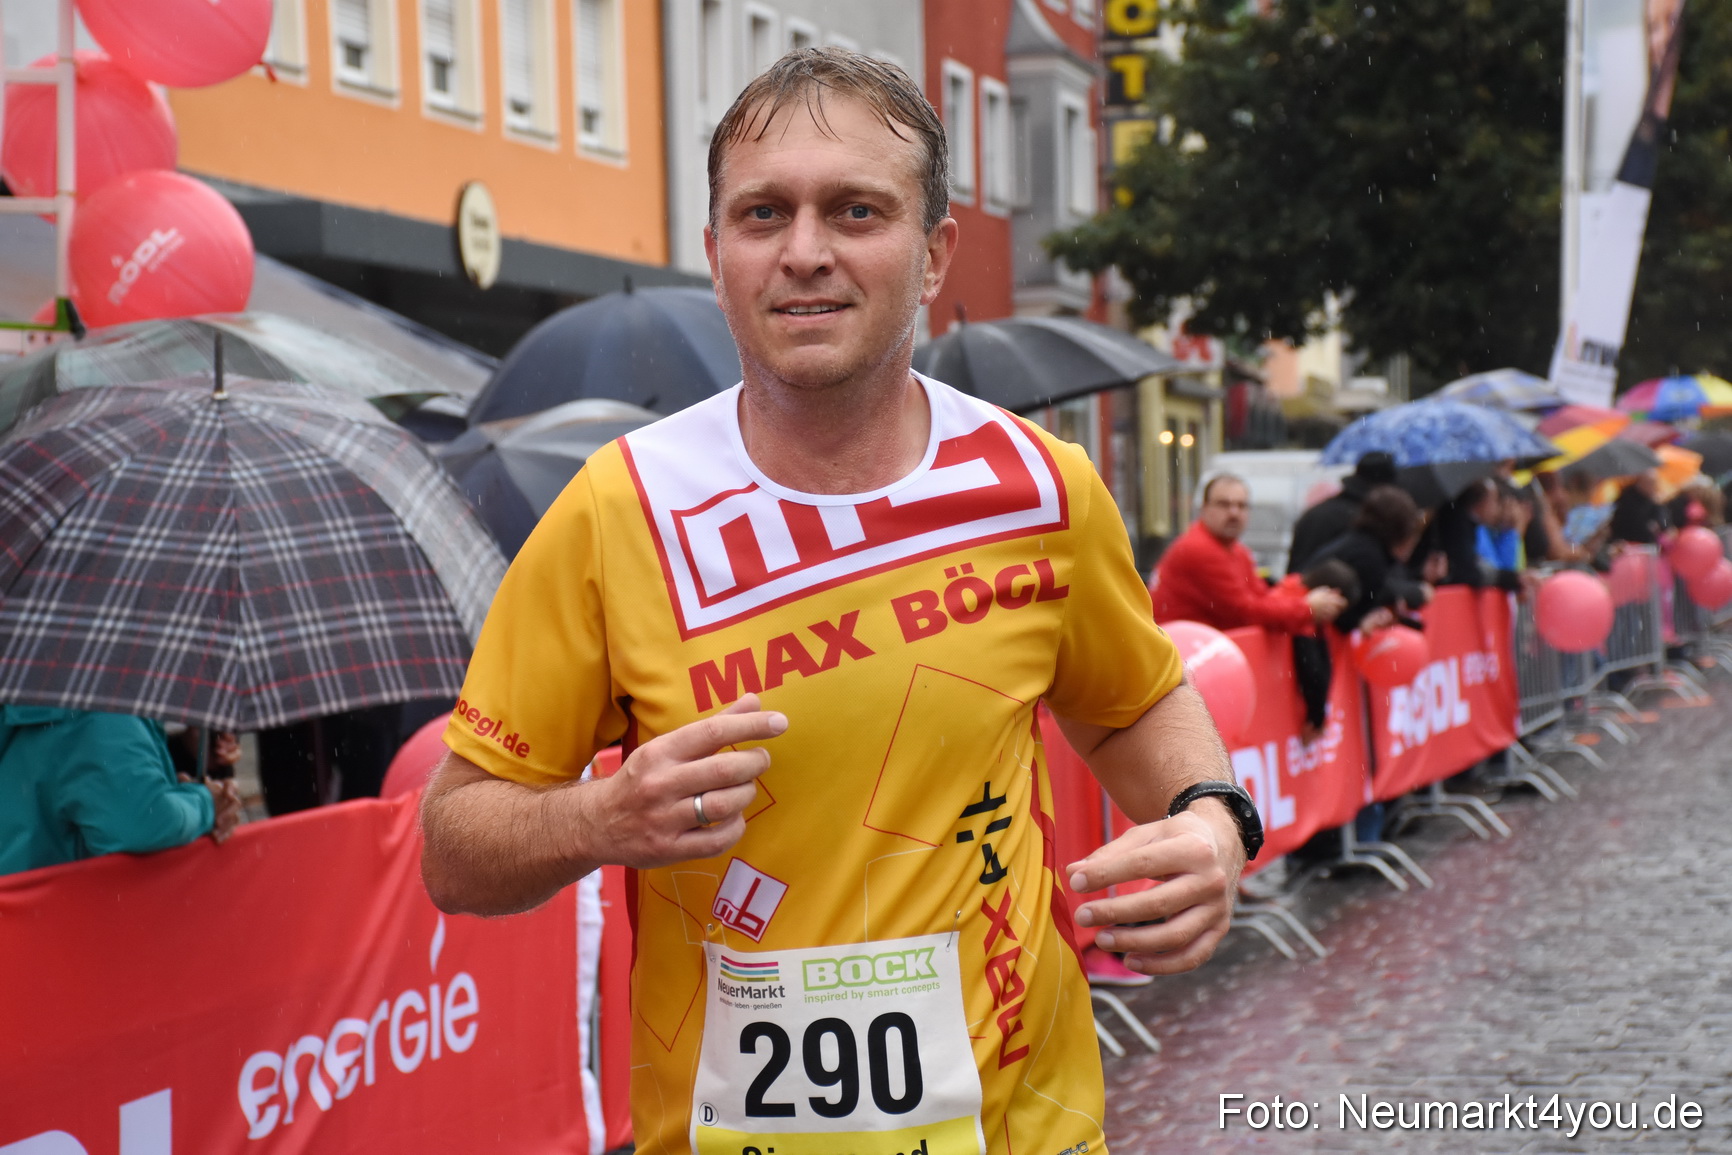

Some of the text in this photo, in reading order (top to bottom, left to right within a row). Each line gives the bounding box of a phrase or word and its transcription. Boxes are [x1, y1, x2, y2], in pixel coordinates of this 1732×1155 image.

[689, 557, 1070, 713] MAX BÖGL
[454, 696, 530, 758] oegl.de
[717, 977, 786, 999] NeuerMarkt
[802, 947, 938, 992] BOCK
[804, 981, 941, 1004] inspired by smart concepts
[739, 1011, 924, 1120] 290
